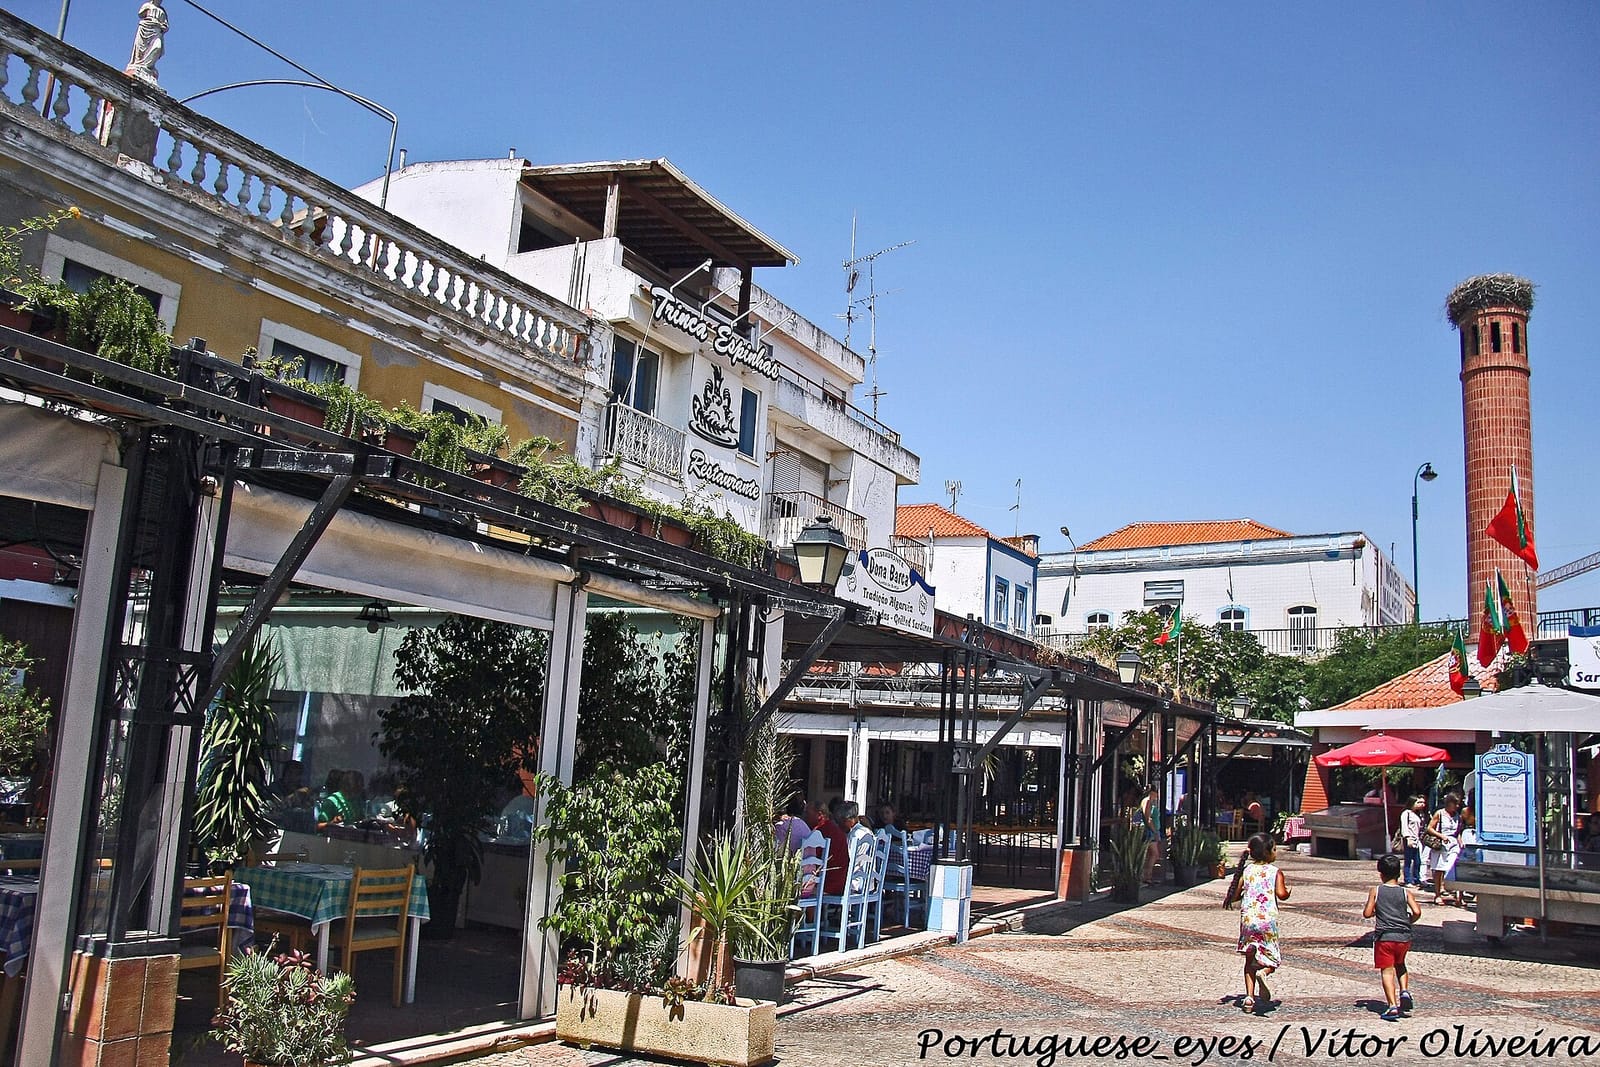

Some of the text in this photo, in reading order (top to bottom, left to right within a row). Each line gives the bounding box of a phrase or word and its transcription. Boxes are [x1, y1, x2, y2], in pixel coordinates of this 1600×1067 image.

[650, 285, 781, 381] Trinca Espinhas
[688, 449, 760, 500] Restaurante
[870, 556, 887, 580] Dona
[890, 564, 908, 587] Barca
[863, 587, 913, 613] Tradição Algarvia
[894, 614, 912, 627] Grilled
[912, 618, 932, 633] Sardines
